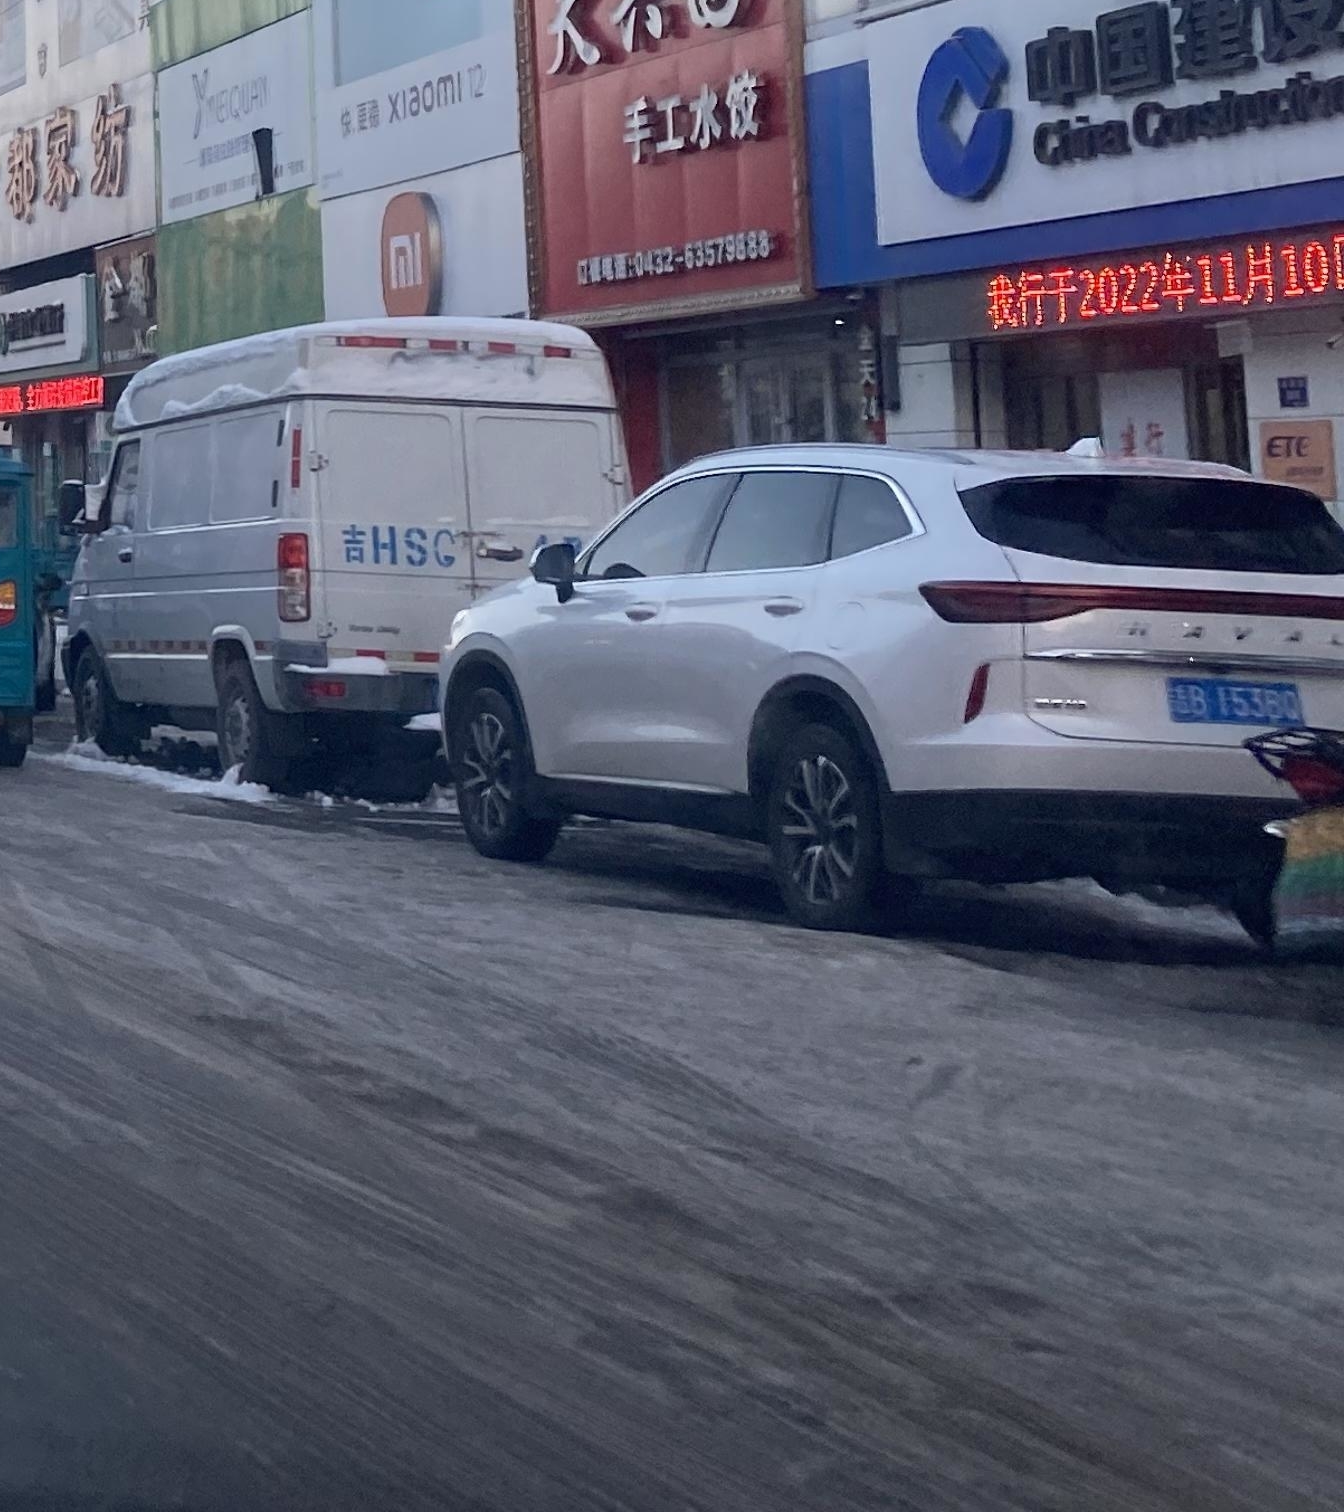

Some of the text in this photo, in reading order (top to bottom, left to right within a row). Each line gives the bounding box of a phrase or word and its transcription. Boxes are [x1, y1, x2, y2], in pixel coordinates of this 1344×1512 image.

[622, 68, 766, 165] 手工水饺
[1033, 115, 1133, 167] China
